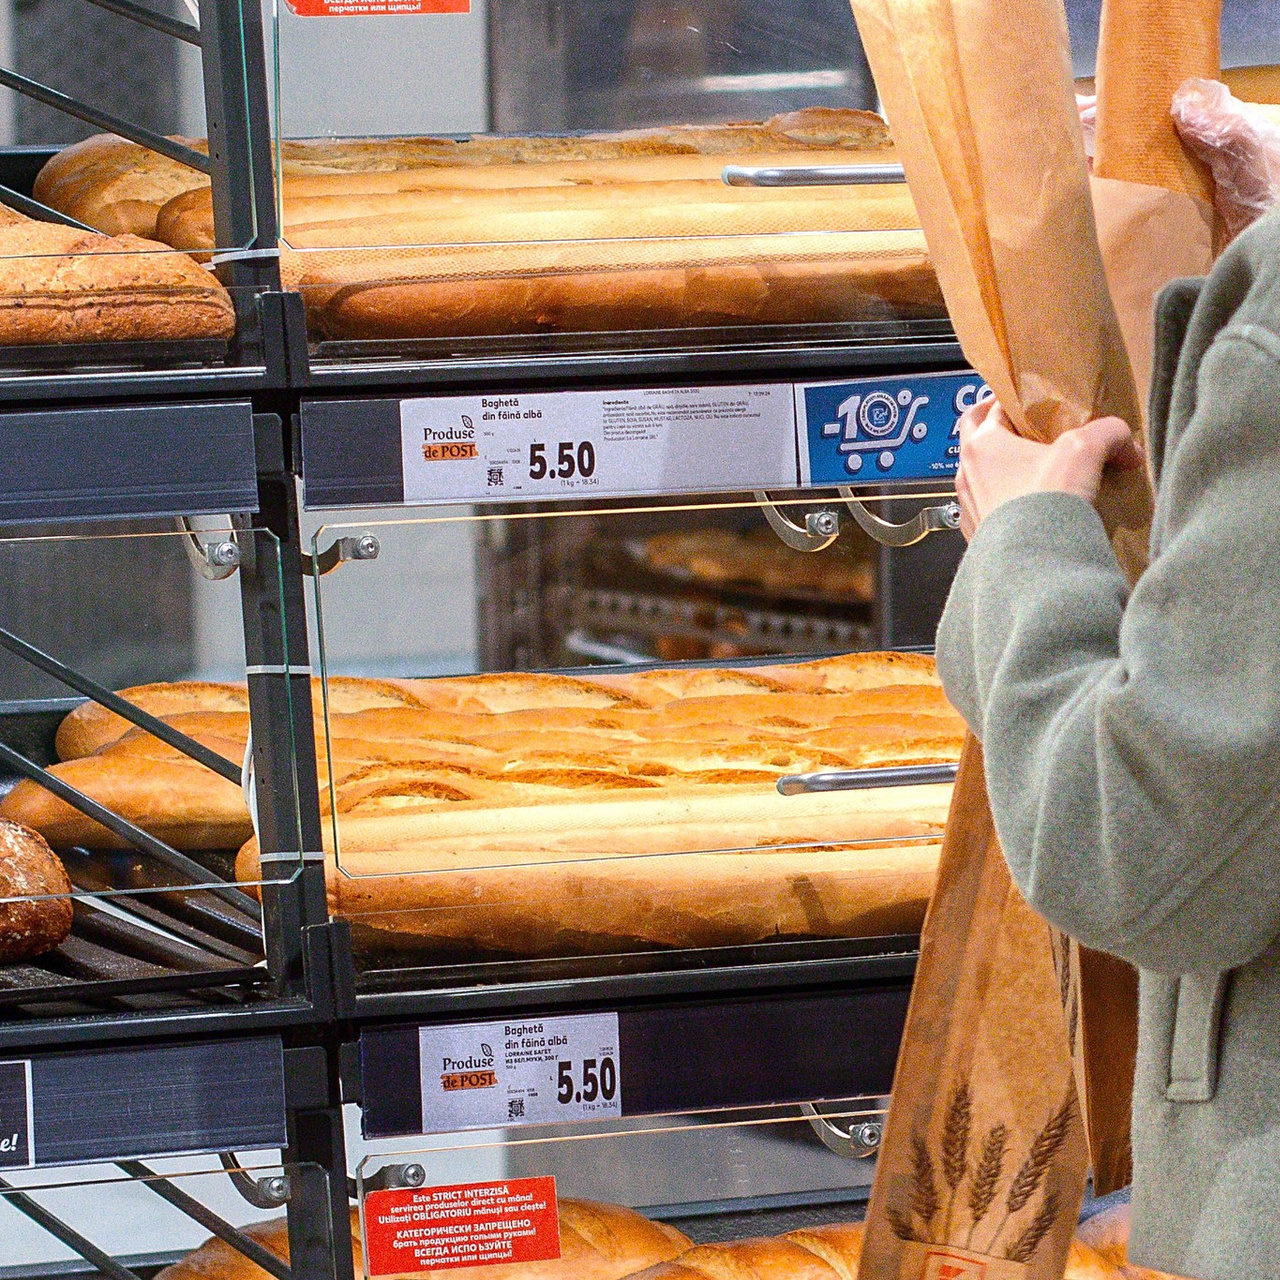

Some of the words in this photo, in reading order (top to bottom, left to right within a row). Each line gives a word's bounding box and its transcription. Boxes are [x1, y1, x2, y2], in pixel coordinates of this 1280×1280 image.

[482, 398, 519, 409] Baghetă
[483, 411, 495, 421] din
[498, 410, 521, 420] făină
[523, 410, 542, 419] albă
[424, 427, 474, 441] Produse
[424, 447, 437, 458] de
[441, 444, 476, 457] POST
[529, 441, 595, 480] 5.50
[505, 1023, 543, 1037] Baghetă
[505, 1040, 519, 1050] din
[522, 1038, 545, 1048] făină
[548, 1036, 568, 1045] albă
[443, 1056, 494, 1071] Produse
[443, 1078, 456, 1088] de
[460, 1072, 495, 1087] POST
[557, 1057, 616, 1105] 5.50
[413, 1194, 431, 1203] Este
[433, 1191, 462, 1202] STRICT
[465, 1186, 509, 1198] INTERZISĂ
[391, 1204, 423, 1213] servirea
[425, 1201, 468, 1211] produselor
[471, 1197, 494, 1206] direct
[508, 1193, 533, 1202] mâna!
[378, 1213, 411, 1224] Utilizați
[413, 1209, 472, 1221] OBLIGATORIU
[474, 1205, 503, 1216] mănuși
[397, 1224, 472, 1239] КАТЕГОРИЧЕСКИ
[474, 1219, 530, 1231] ЗАПРЕЩЕНО
[393, 1239, 418, 1249] брать
[420, 1235, 468, 1246] продукцию
[470, 1232, 501, 1241] голыми
[504, 1228, 536, 1239] руками!
[414, 1247, 449, 1257] ВСЕГДА
[420, 1256, 460, 1266] перчатки
[461, 1254, 477, 1262] или
[479, 1250, 512, 1261] щипцы!
